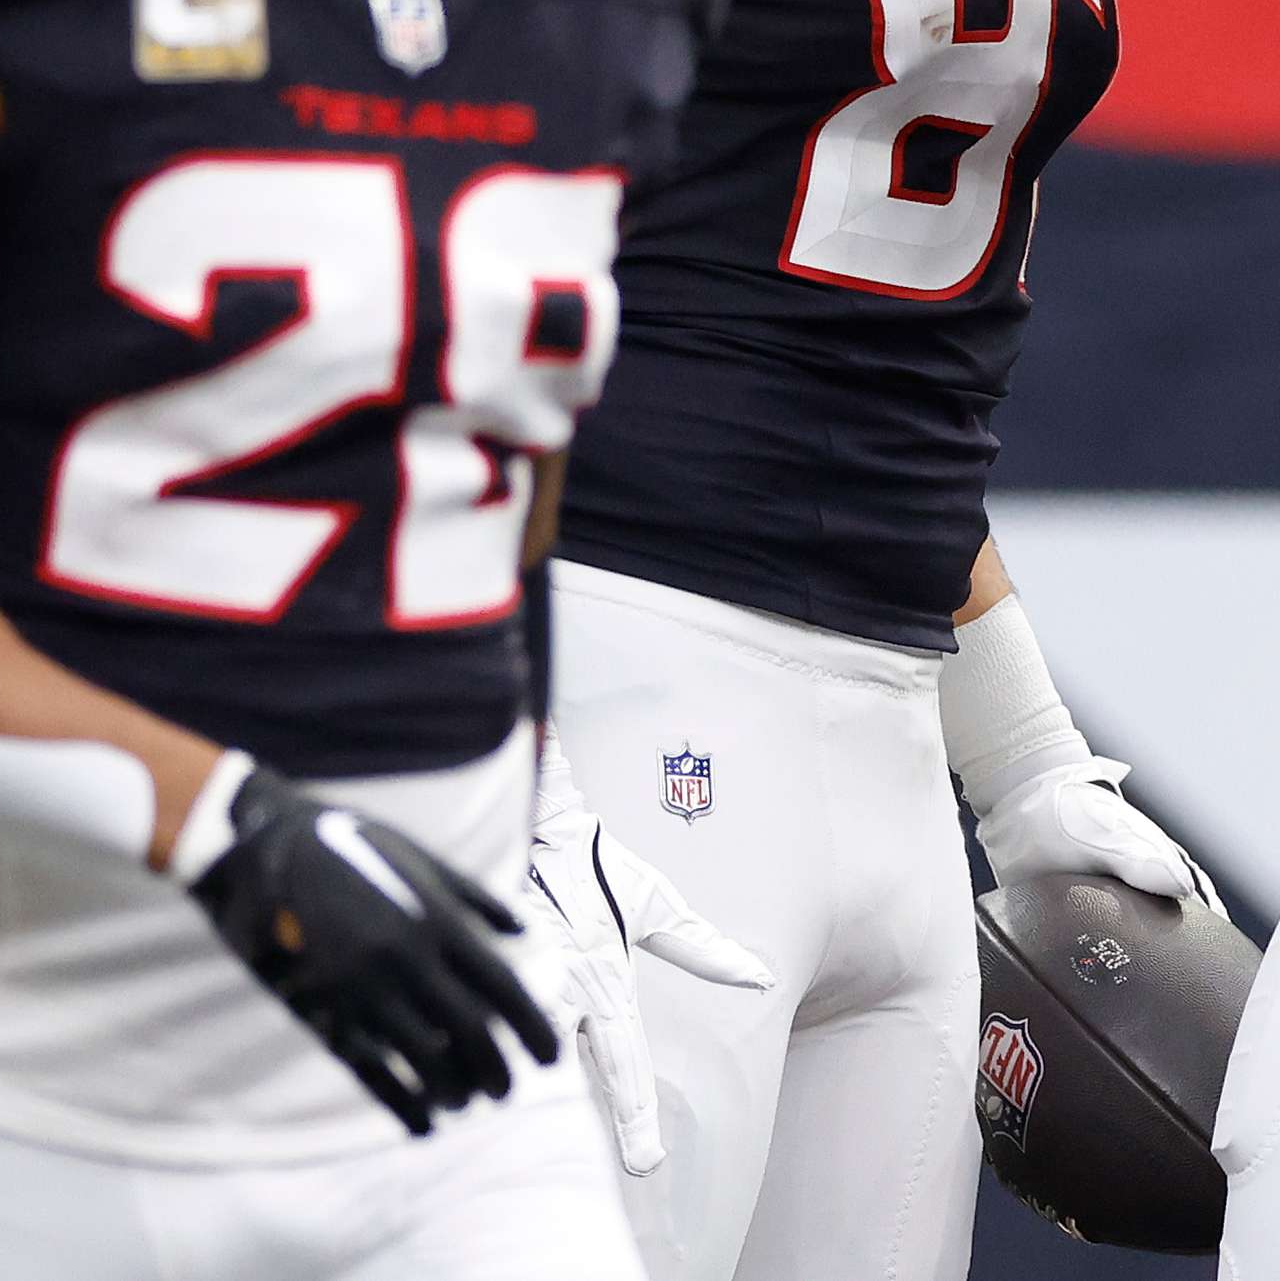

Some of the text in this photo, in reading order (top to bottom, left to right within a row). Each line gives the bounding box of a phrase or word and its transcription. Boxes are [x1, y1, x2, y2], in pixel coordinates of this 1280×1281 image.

[281, 82, 537, 147] TEXANS
[37, 149, 628, 631] 28
[670, 776, 709, 809] NFL
[982, 1023, 1036, 1108] NFL
